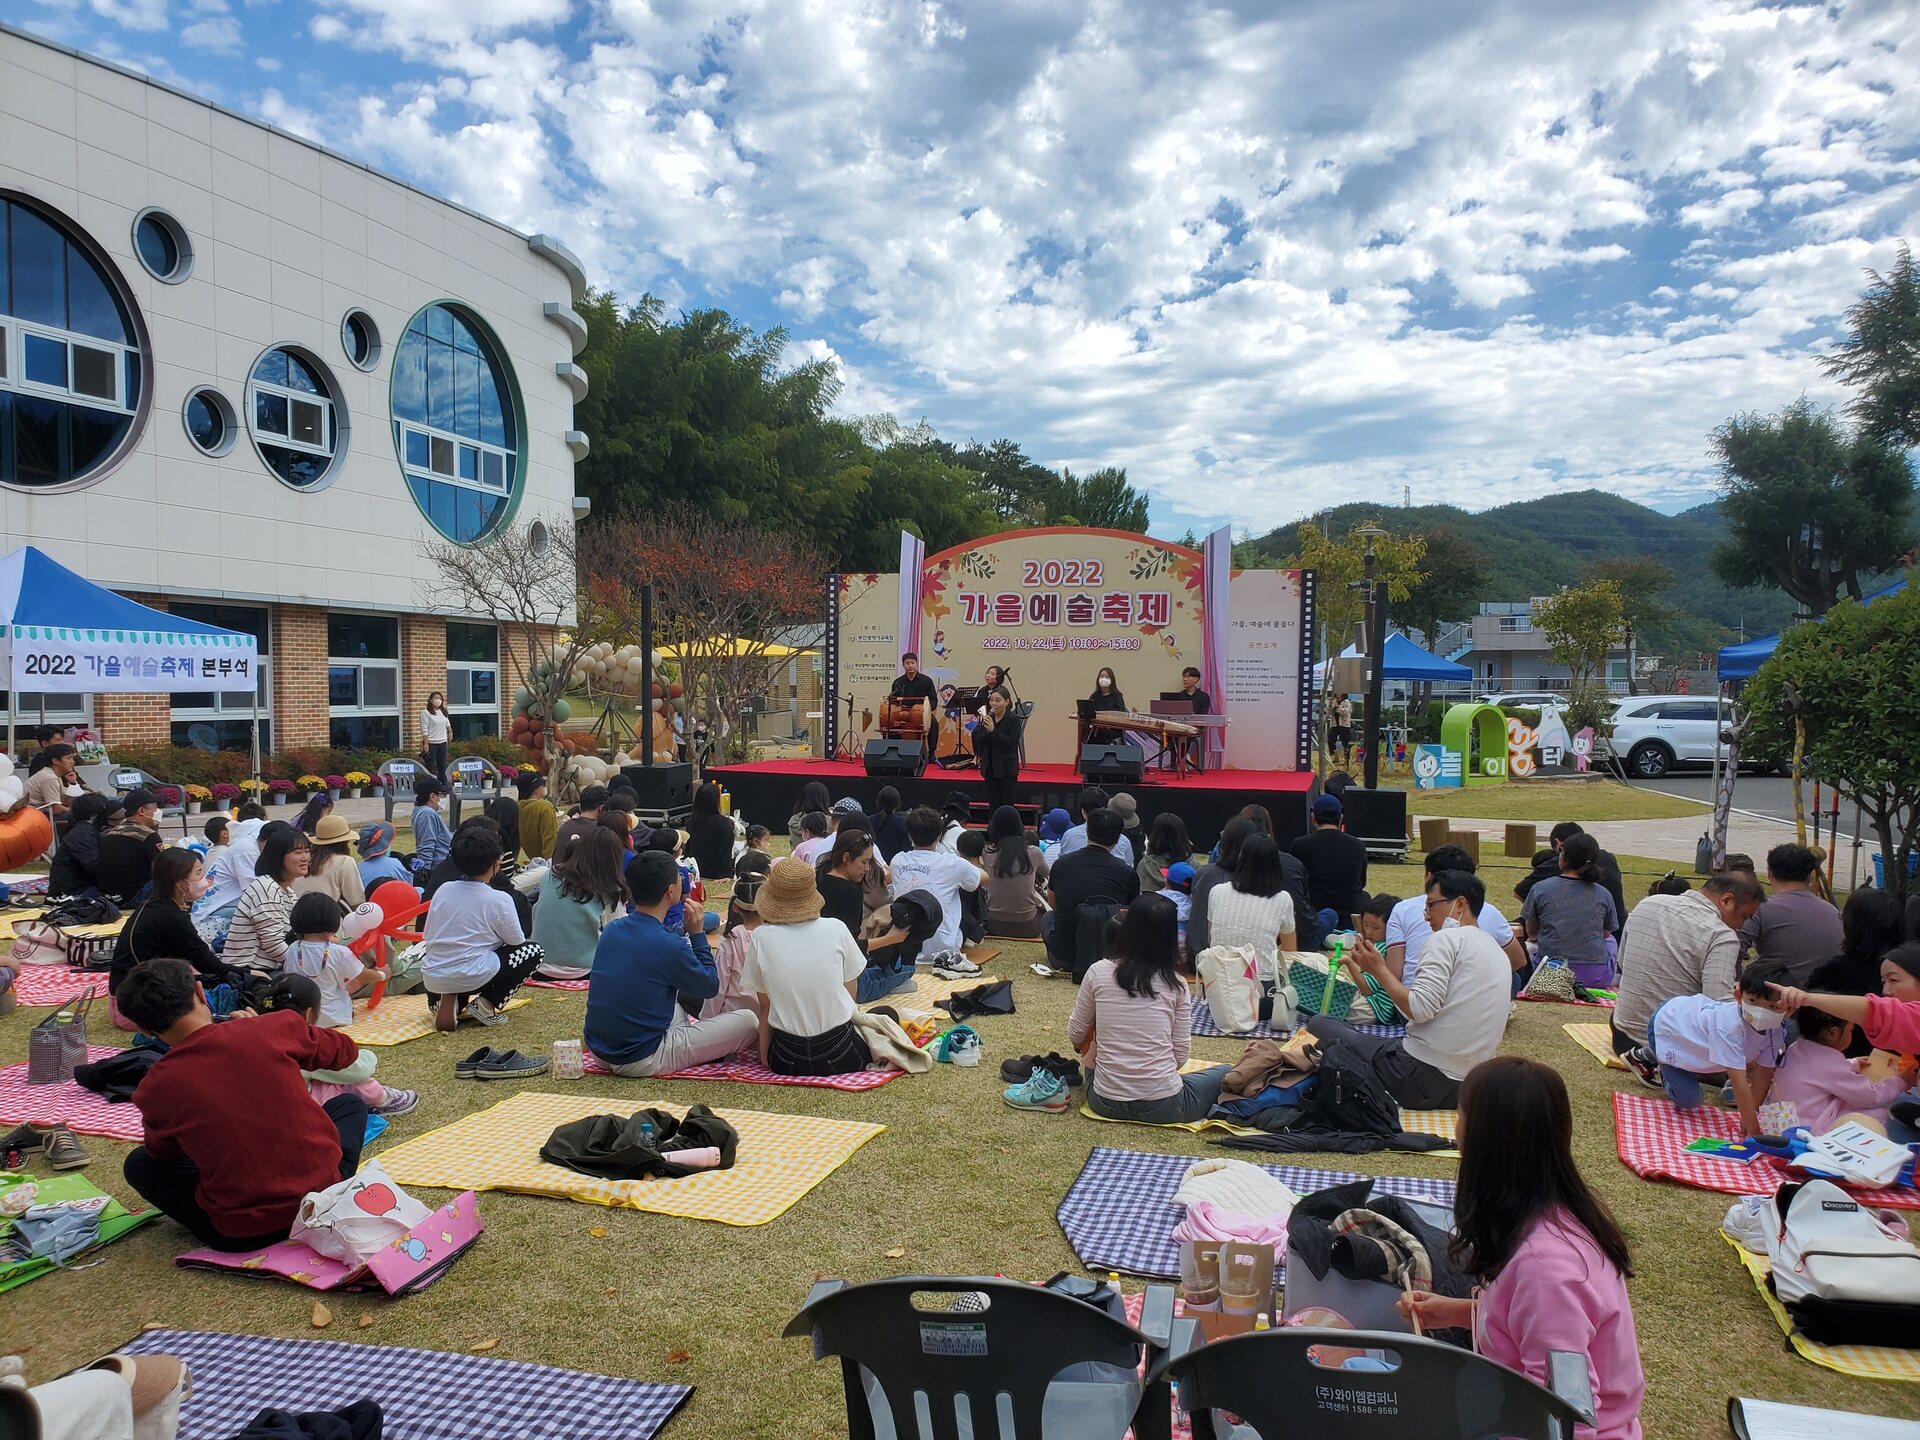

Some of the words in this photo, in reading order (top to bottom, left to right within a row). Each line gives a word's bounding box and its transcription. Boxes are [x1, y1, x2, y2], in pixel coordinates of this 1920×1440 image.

[1023, 560, 1103, 585] 2022
[958, 592, 1170, 625] 가을예술축제
[983, 637, 1011, 648] 2022.
[1014, 638, 1029, 648] 10.
[25, 654, 76, 675] 2022
[84, 655, 195, 678] 가을예술축제
[201, 658, 248, 678] 본부석
[1823, 1202, 1856, 1210] Discovery
[1315, 1385, 1398, 1405] (주)와이엠컴퍼니
[1317, 1401, 1349, 1412] 고객센터
[1352, 1406, 1398, 1415] 1588-9569
